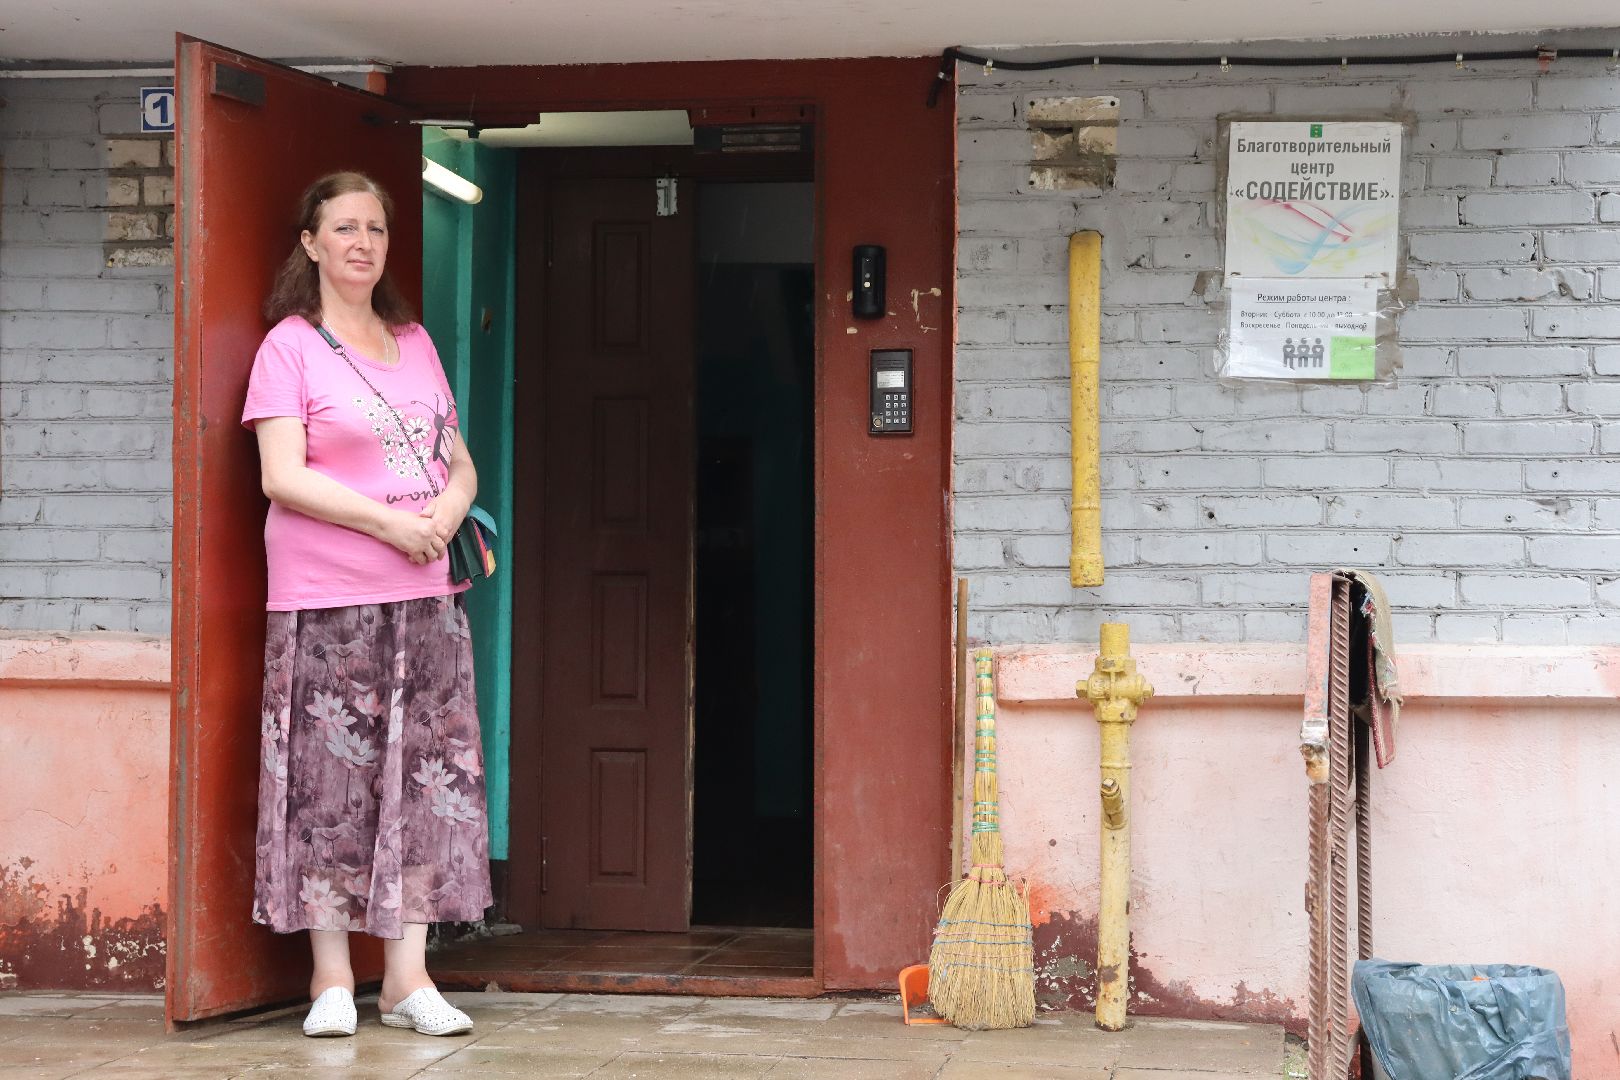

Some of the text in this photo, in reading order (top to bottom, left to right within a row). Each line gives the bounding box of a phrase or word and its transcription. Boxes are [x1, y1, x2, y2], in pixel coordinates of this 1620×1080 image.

[153, 95, 168, 124] 1
[1237, 137, 1391, 156] Благотворительный
[1291, 162, 1334, 177] центр
[1257, 293, 1285, 302] Режим
[1286, 292, 1316, 304] работы
